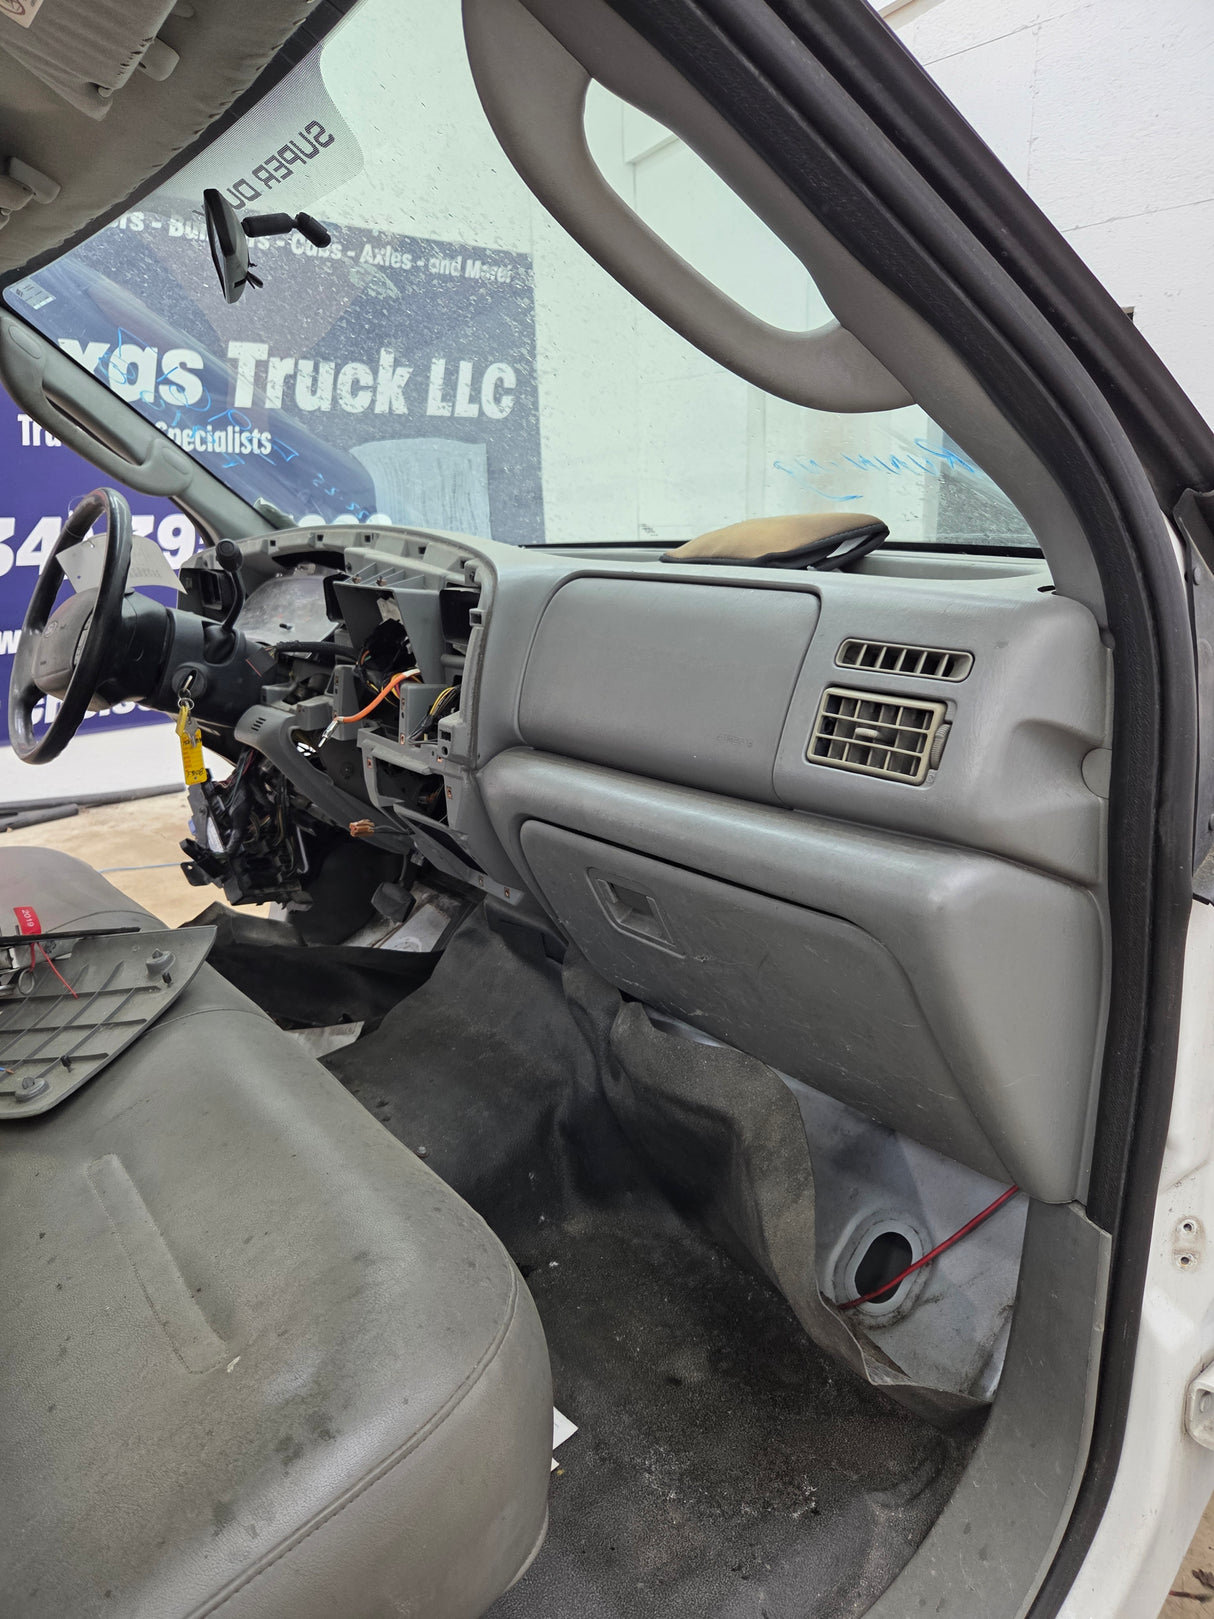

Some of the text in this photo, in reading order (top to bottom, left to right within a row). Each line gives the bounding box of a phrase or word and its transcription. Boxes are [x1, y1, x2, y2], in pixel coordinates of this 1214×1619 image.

[360, 243, 412, 270] Axles
[428, 255, 463, 277] and
[58, 338, 204, 406] xas
[228, 341, 413, 414] Truck
[426, 358, 517, 419] LLC
[17, 413, 62, 447] Tru
